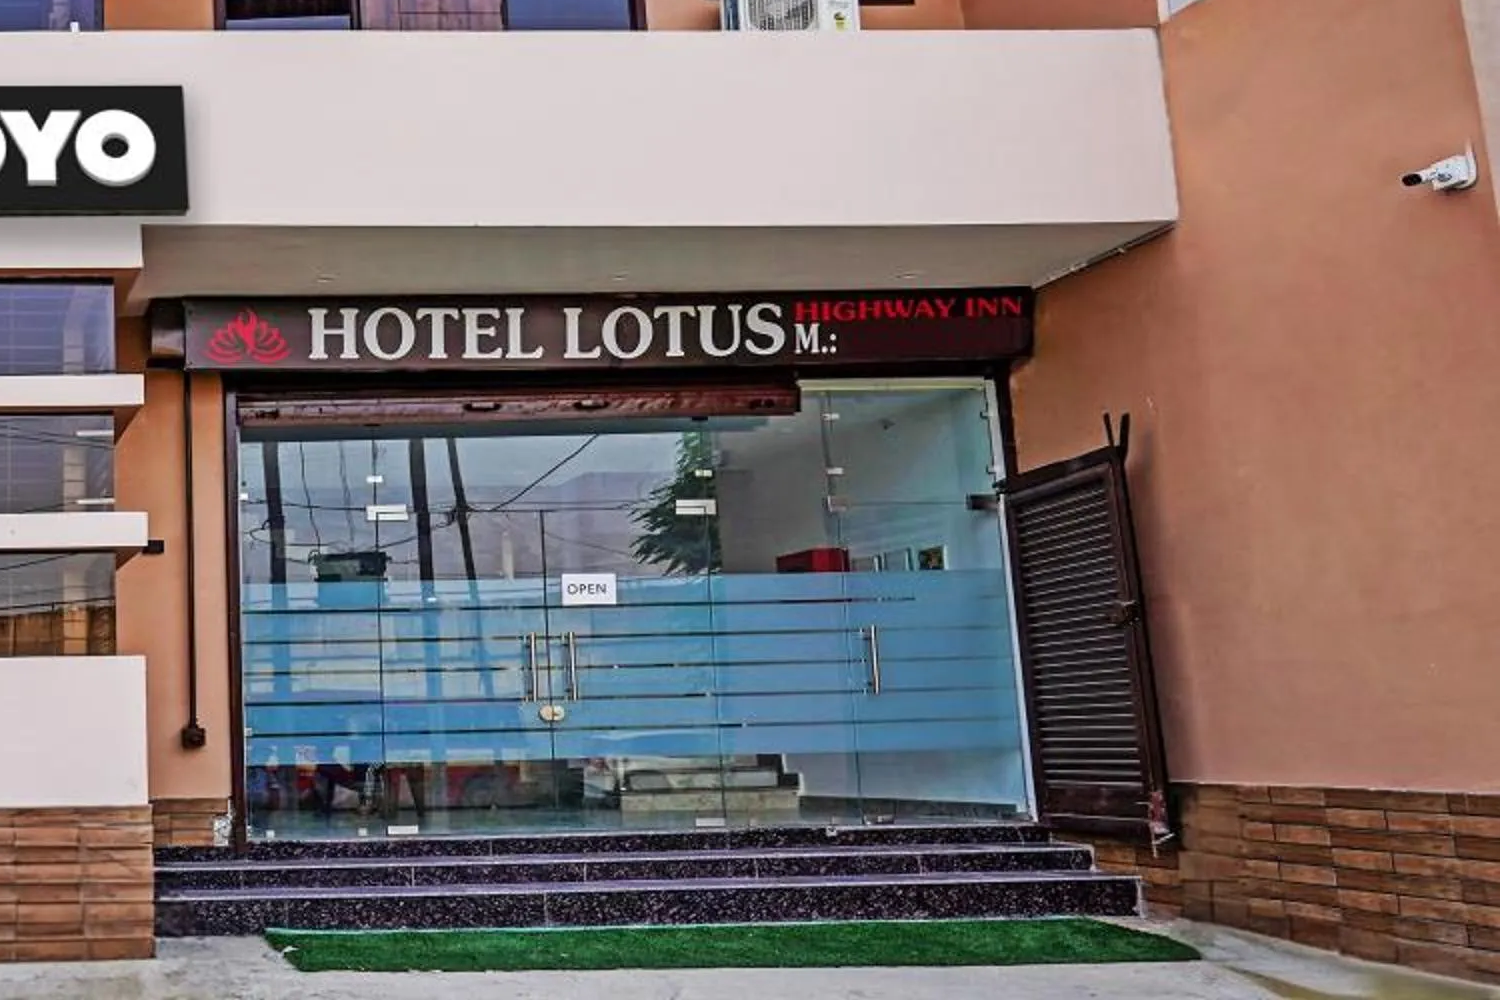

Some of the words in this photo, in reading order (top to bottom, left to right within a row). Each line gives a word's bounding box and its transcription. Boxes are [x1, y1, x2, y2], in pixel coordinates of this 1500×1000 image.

[794, 298, 955, 321] HIGHWAY
[964, 296, 1023, 317] INN
[307, 307, 544, 361] HOTEL
[563, 303, 786, 360] LOTUS
[567, 583, 607, 595] OPEN
